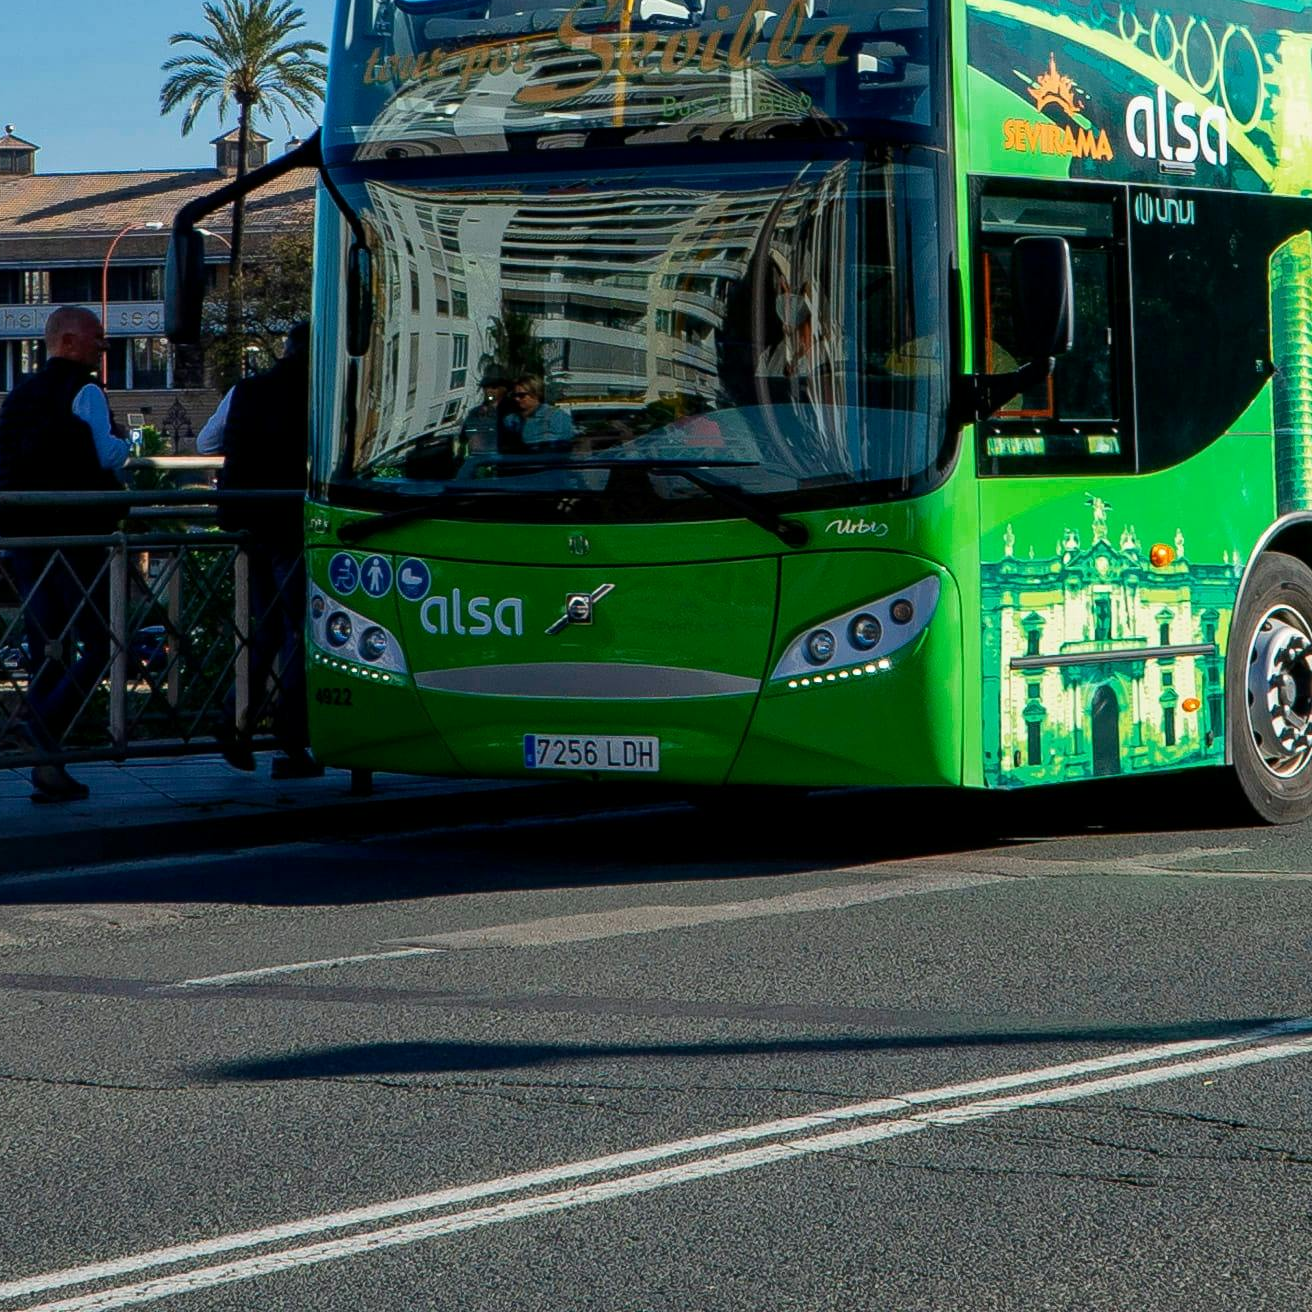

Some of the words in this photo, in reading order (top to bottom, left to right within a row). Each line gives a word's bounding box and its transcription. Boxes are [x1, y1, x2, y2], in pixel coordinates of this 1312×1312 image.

[363, 46, 448, 84] tour
[458, 41, 534, 93] por
[1003, 117, 1114, 162] SEVIRAMA
[1125, 85, 1229, 167] alsa
[420, 587, 523, 636] alsa
[316, 687, 353, 706] 4922
[537, 739, 598, 765] 7256
[606, 741, 654, 767] LDH
